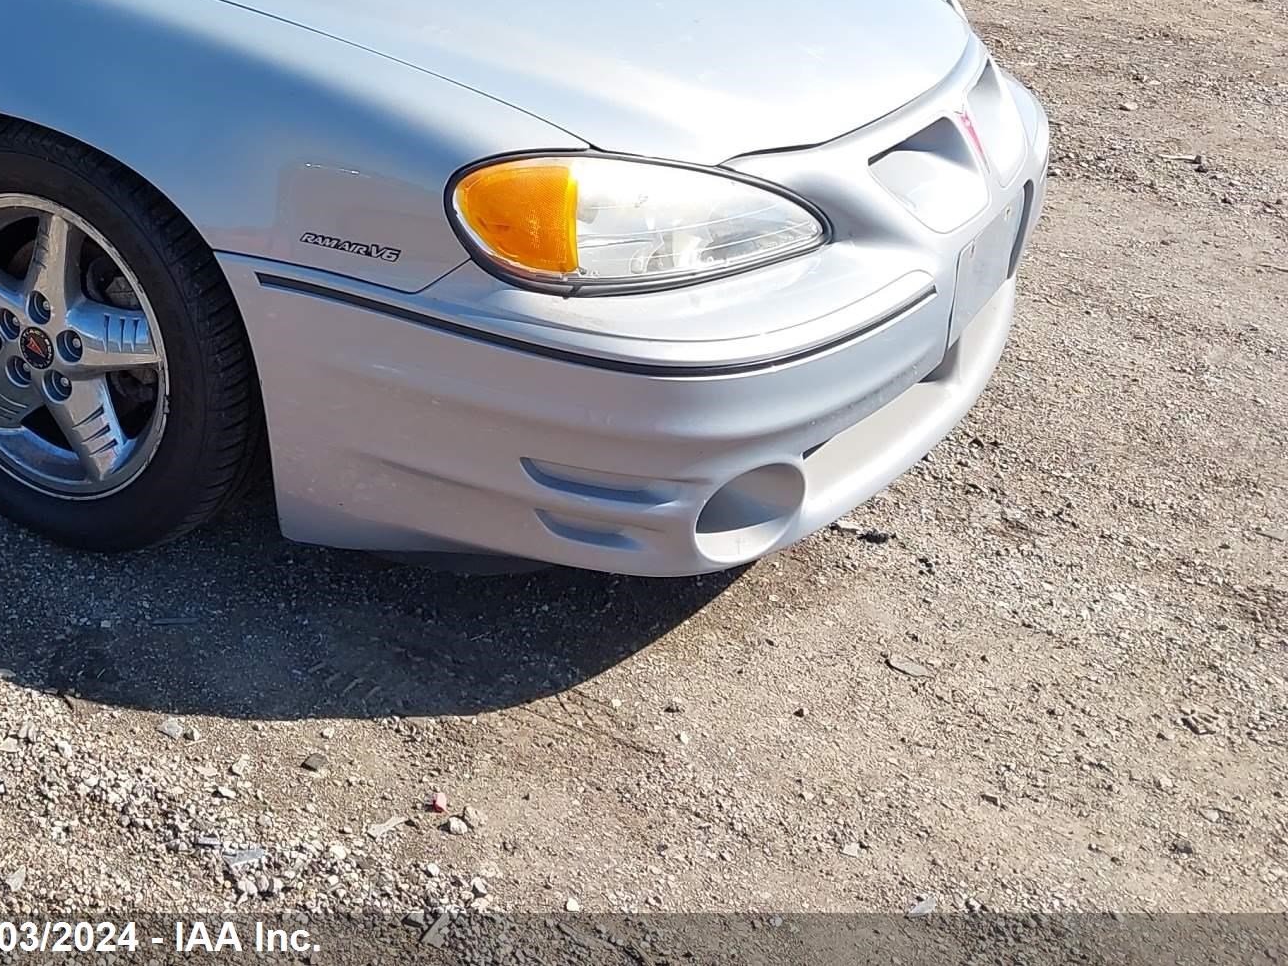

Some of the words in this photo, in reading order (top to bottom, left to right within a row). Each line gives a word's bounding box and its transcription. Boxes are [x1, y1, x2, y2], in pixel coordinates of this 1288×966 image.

[300, 232, 339, 249] RAM
[337, 240, 370, 255] AIR
[369, 244, 402, 262] V6
